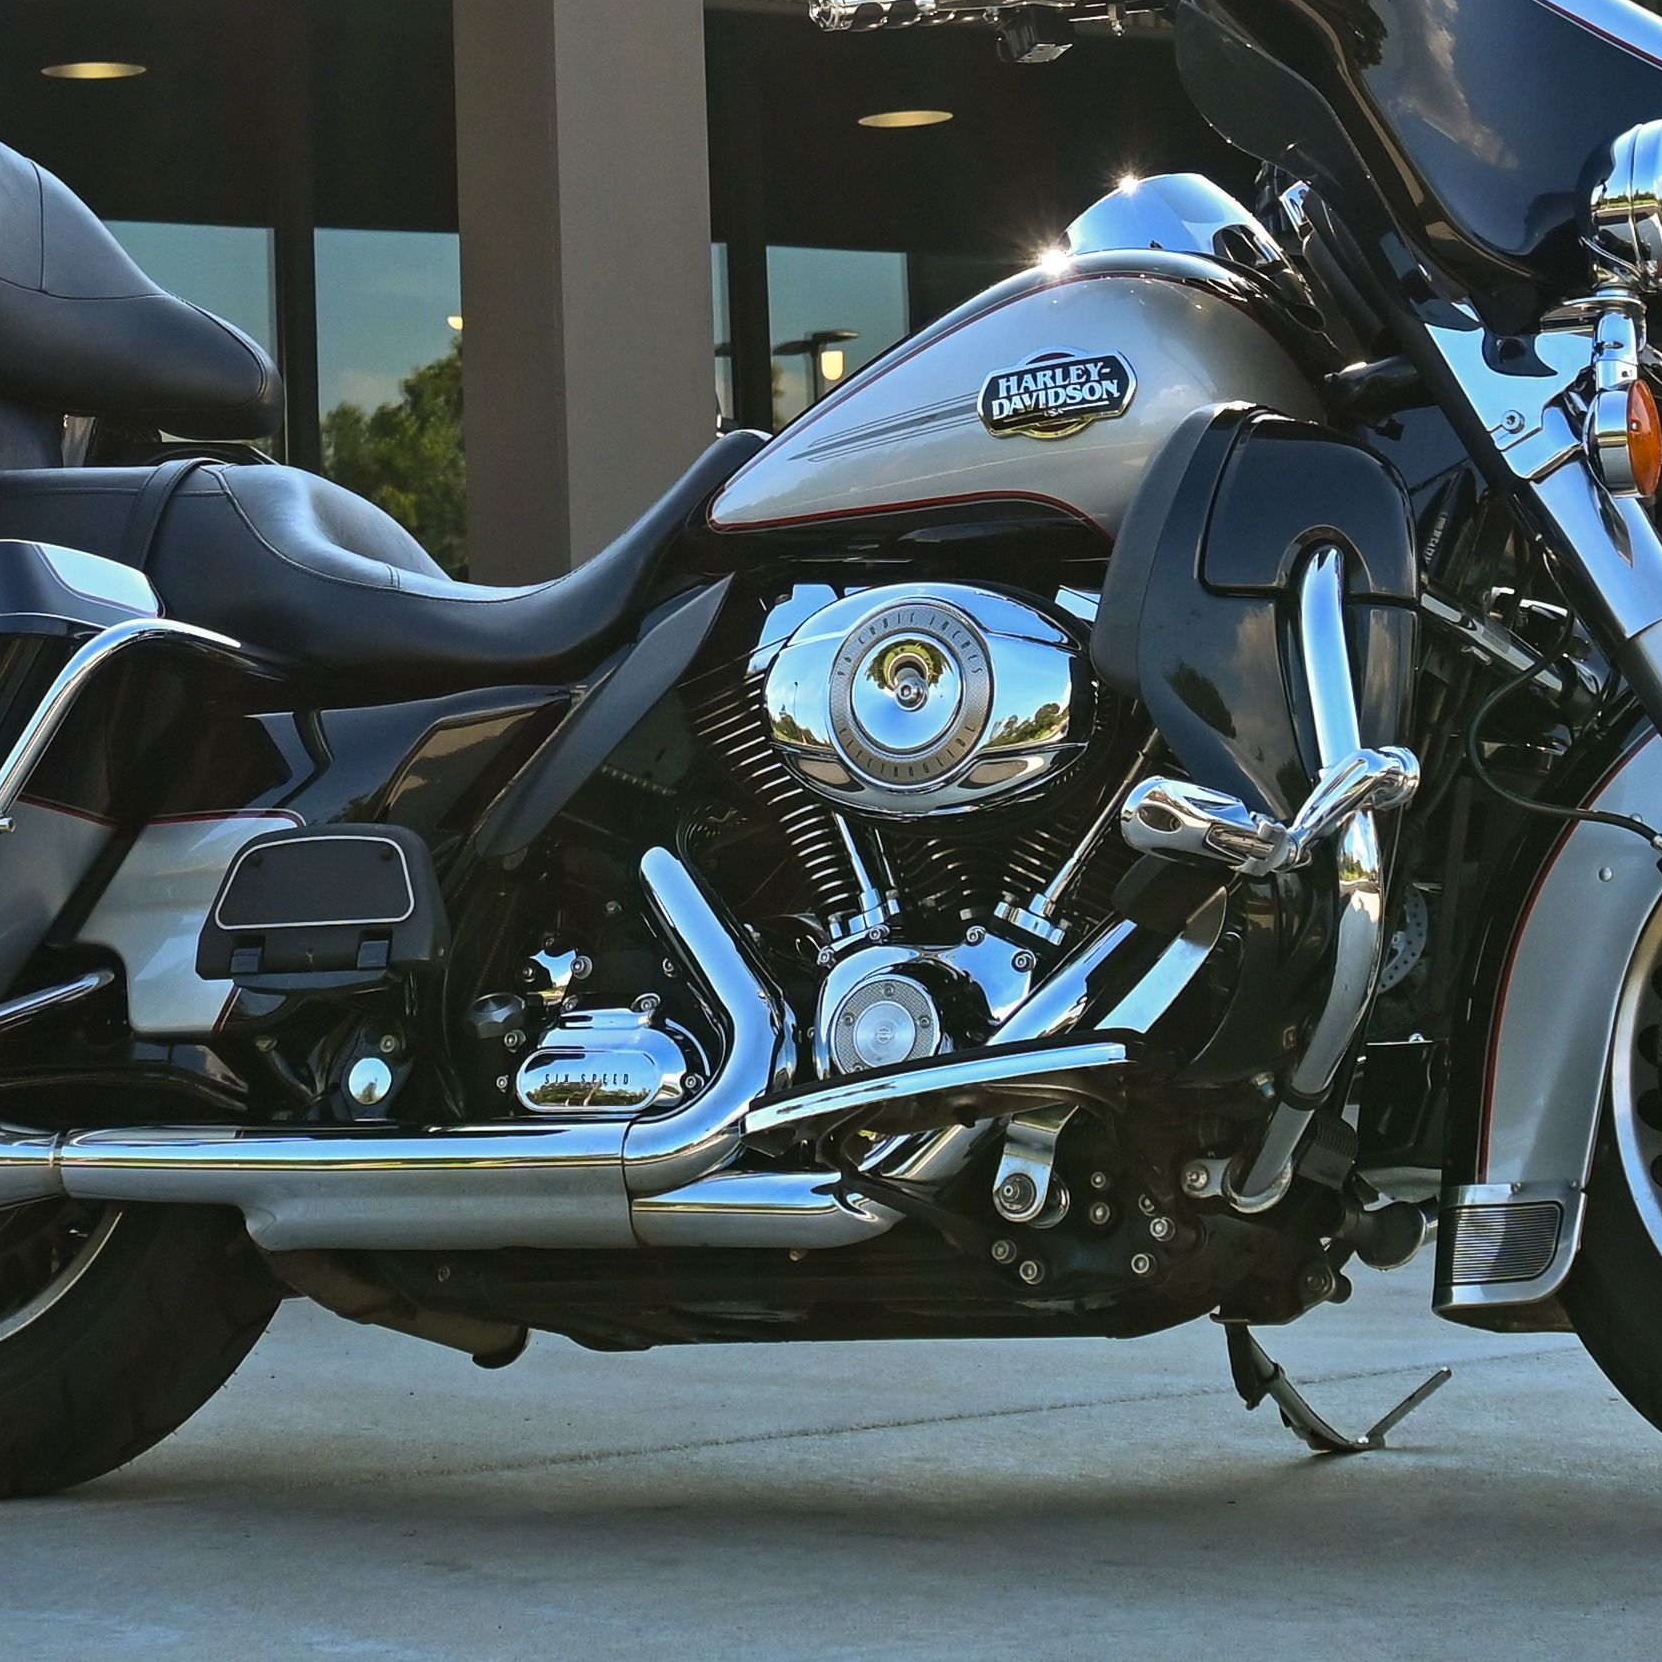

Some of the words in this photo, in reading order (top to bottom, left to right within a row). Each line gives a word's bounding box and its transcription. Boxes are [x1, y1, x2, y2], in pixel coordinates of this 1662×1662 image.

[998, 361, 1111, 398] HARLEY-
[991, 380, 1120, 420] DAVIDSON
[544, 1073, 570, 1085] SIX
[580, 1073, 629, 1085] SPEED
